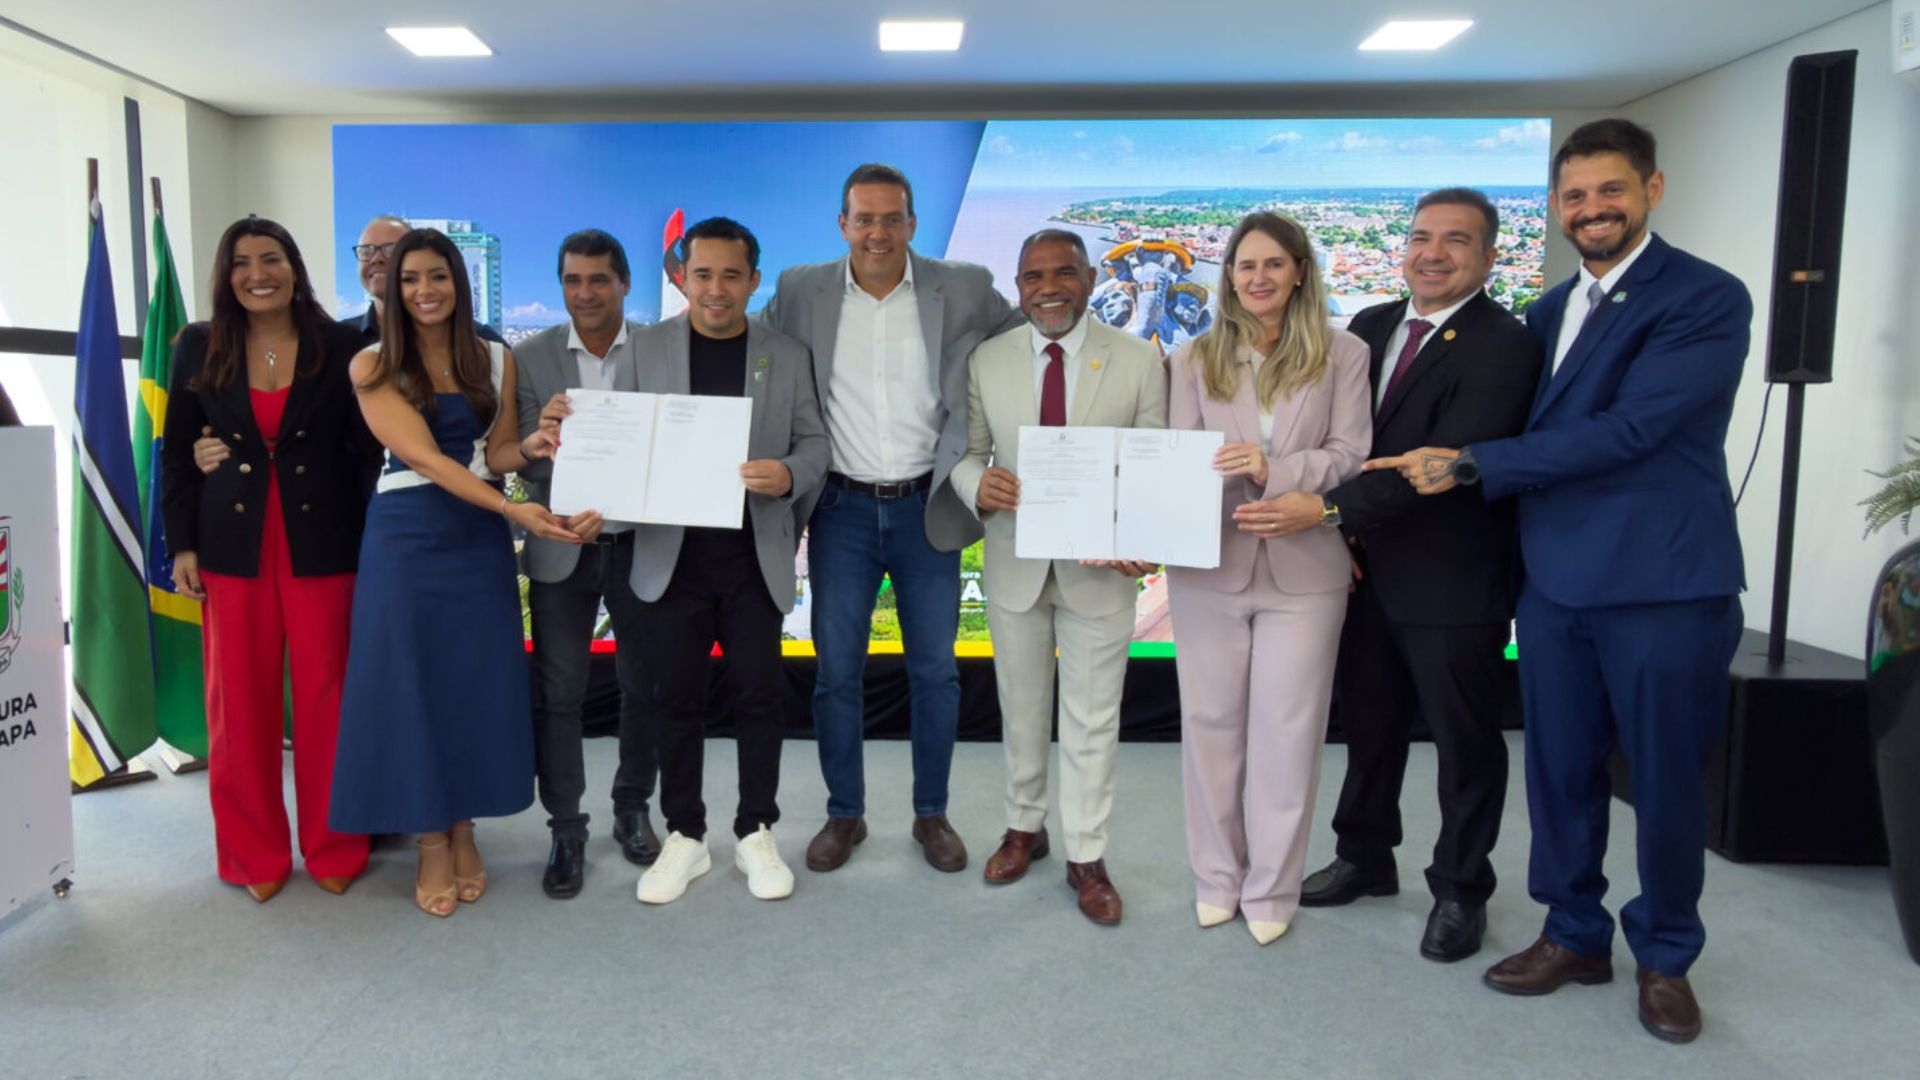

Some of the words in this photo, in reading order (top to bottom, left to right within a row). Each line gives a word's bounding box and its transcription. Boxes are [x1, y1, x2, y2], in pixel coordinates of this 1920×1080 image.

[960, 579, 987, 601] A
[0, 692, 38, 721] URA
[0, 719, 37, 747] APA
